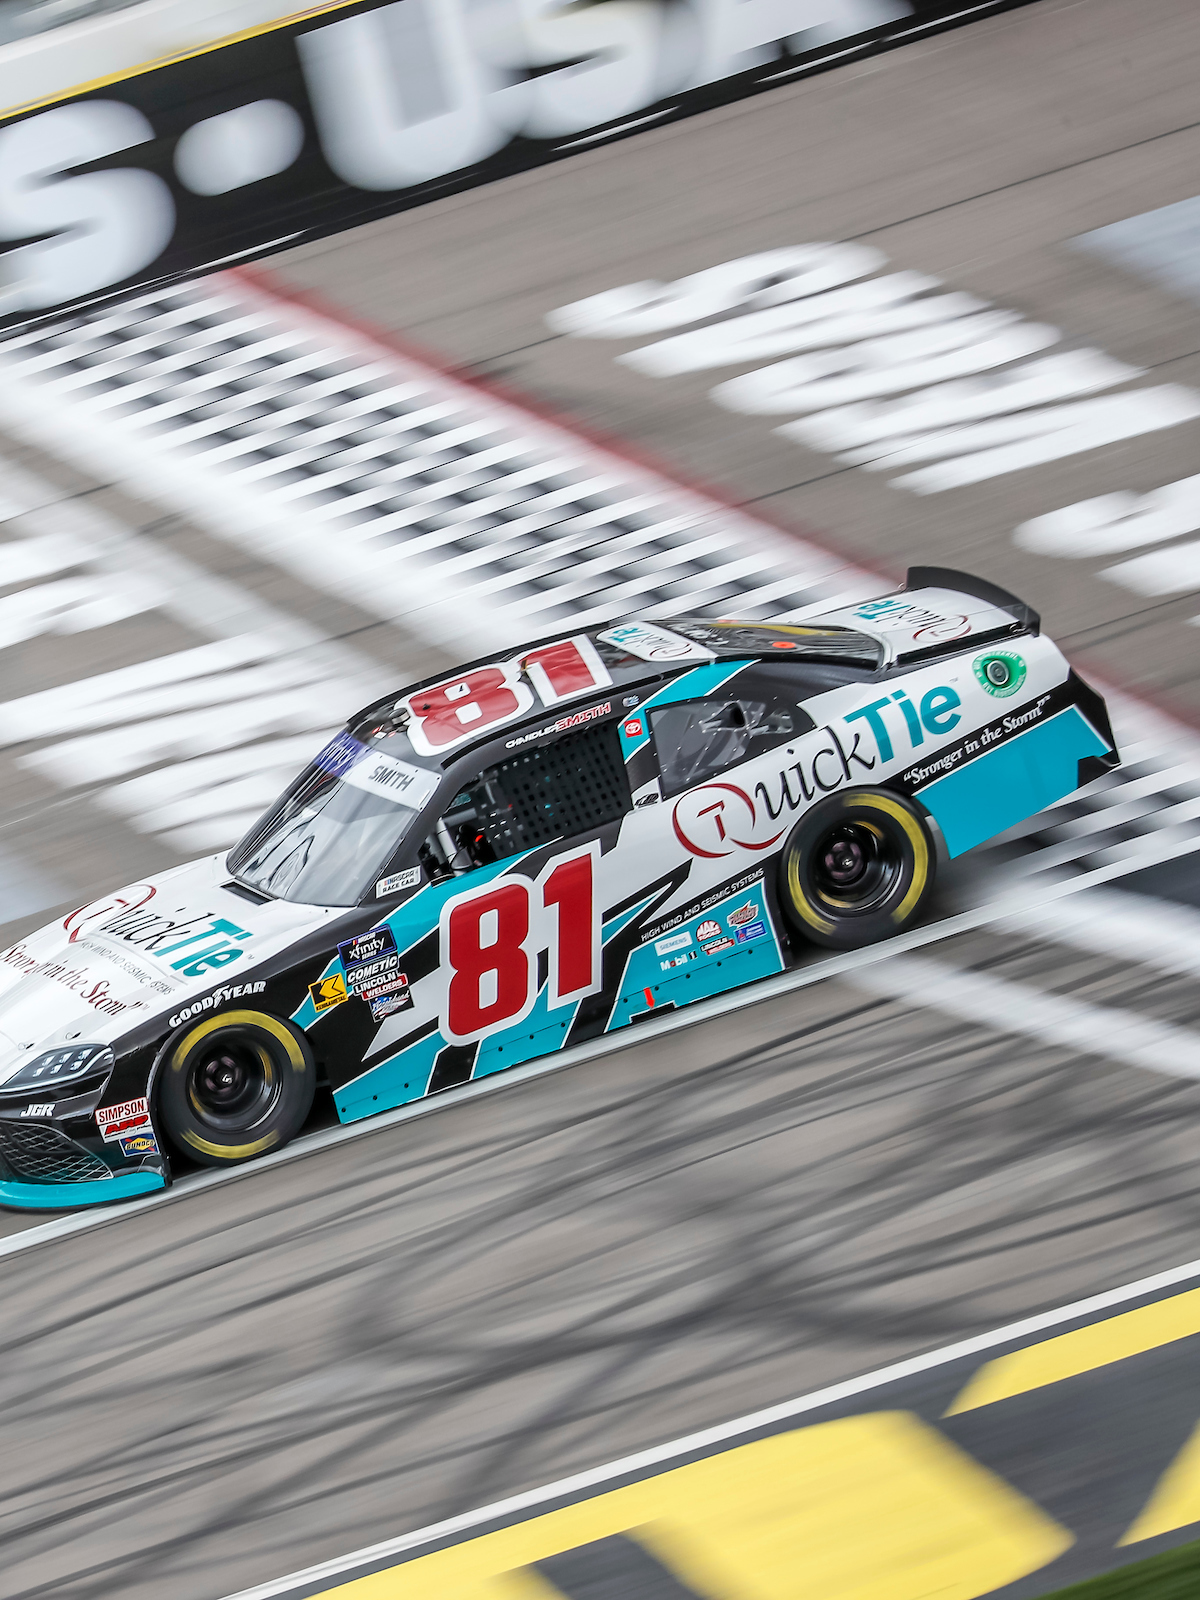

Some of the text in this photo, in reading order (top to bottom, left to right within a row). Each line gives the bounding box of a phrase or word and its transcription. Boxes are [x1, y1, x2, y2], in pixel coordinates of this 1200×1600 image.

[400, 636, 606, 752] 81
[555, 702, 612, 732] SMITH
[964, 738, 981, 757] in
[980, 727, 1003, 749] the
[368, 765, 416, 792] SMITH
[672, 686, 962, 859] QuickTie
[640, 867, 765, 942] HIGH WIND AND SEISMIC SYSTEMS
[349, 937, 385, 960] xfinity
[444, 845, 598, 1040] 81
[659, 936, 688, 951] SIEMENS
[347, 955, 398, 984] COMETIC
[659, 954, 688, 971] Mobil
[355, 971, 397, 993] LINCOLN
[365, 979, 404, 998] WELDERS
[168, 980, 267, 1029] GOODYEAR
[20, 1103, 56, 1117] JGR
[98, 1098, 146, 1123] SIMPSON
[104, 1114, 149, 1136] ARP
[124, 1138, 156, 1151] SUNOCO
